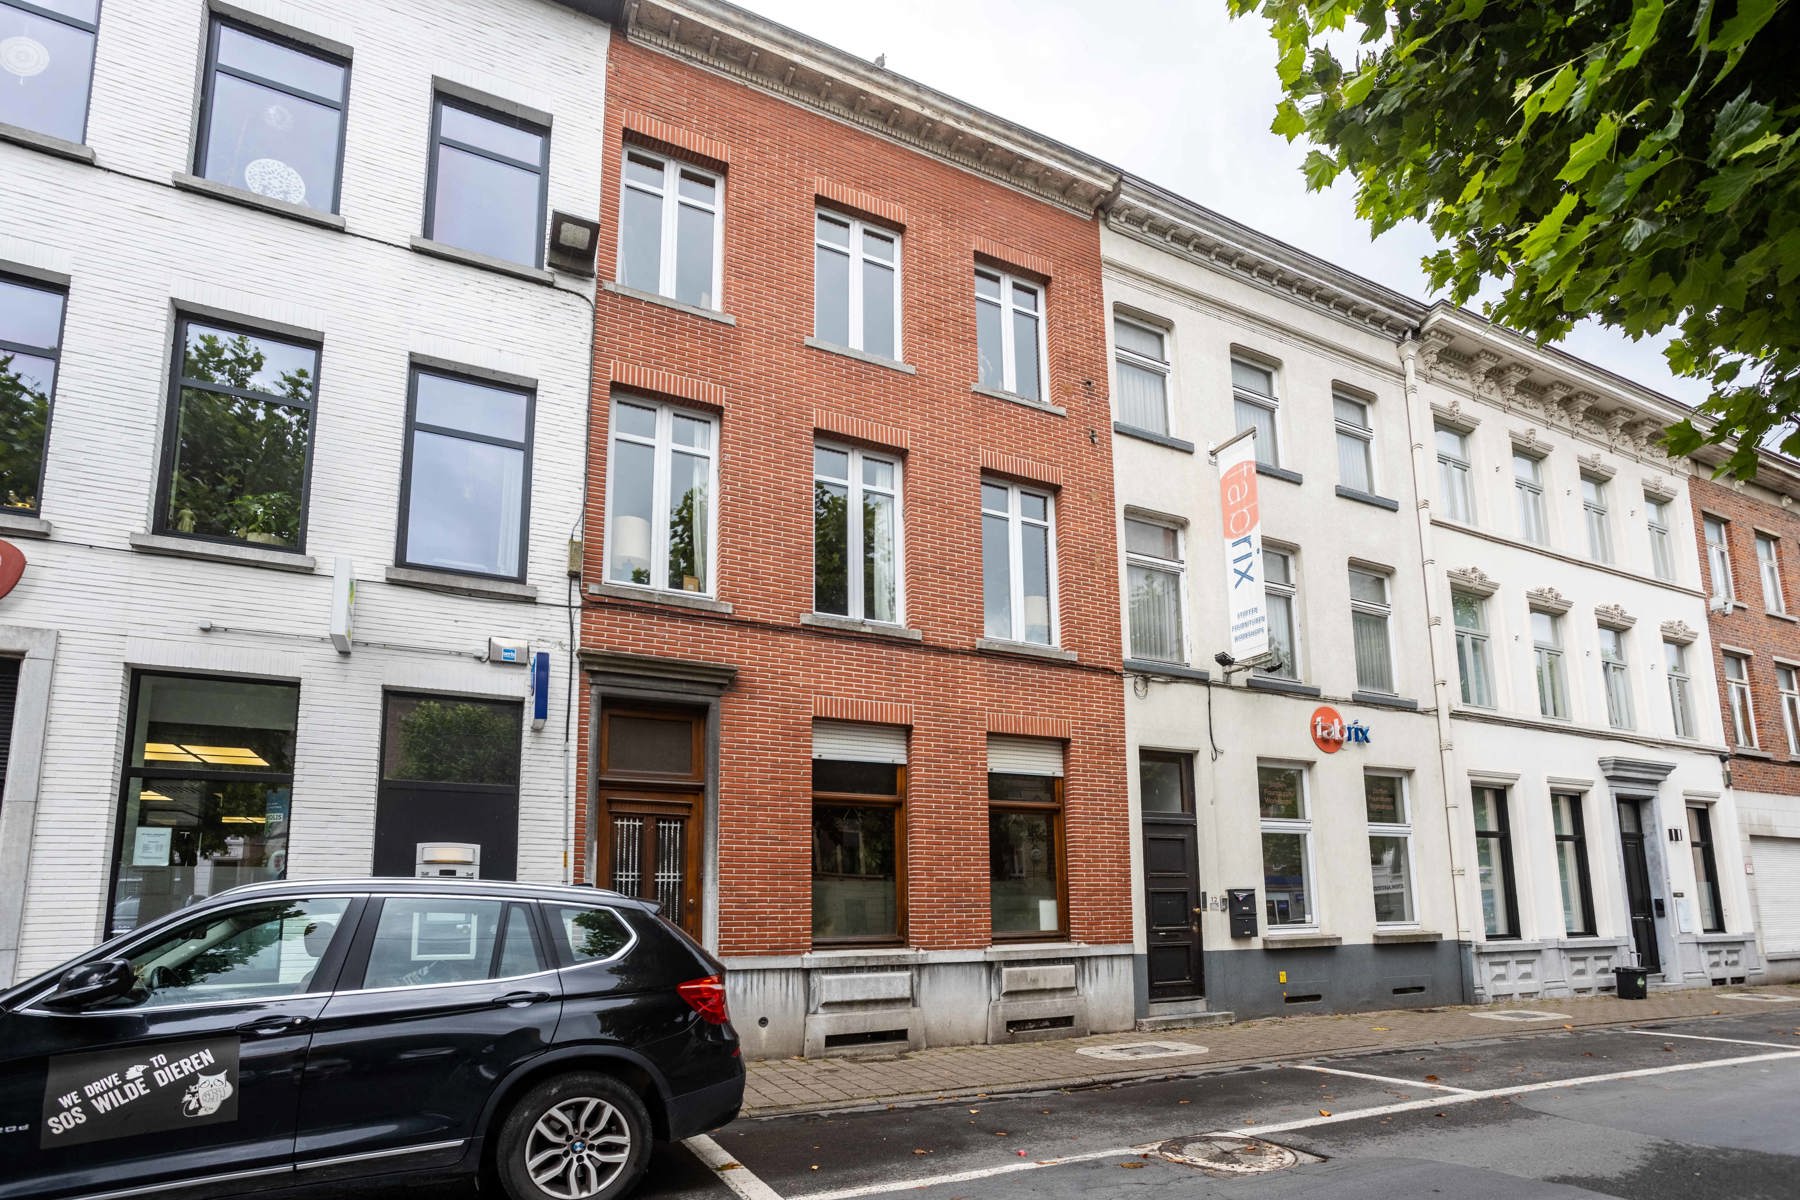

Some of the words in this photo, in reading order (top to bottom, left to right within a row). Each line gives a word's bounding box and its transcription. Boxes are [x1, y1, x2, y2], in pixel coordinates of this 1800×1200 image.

[1227, 463, 1261, 589] fabrix
[1315, 716, 1370, 743] fabrix
[48, 1106, 87, 1135] SOS
[91, 1078, 151, 1115] WILDE
[153, 1048, 216, 1088] DIEREN
[58, 1090, 82, 1109] WE
[84, 1073, 122, 1098] DRIVE
[150, 1054, 168, 1068] TO
